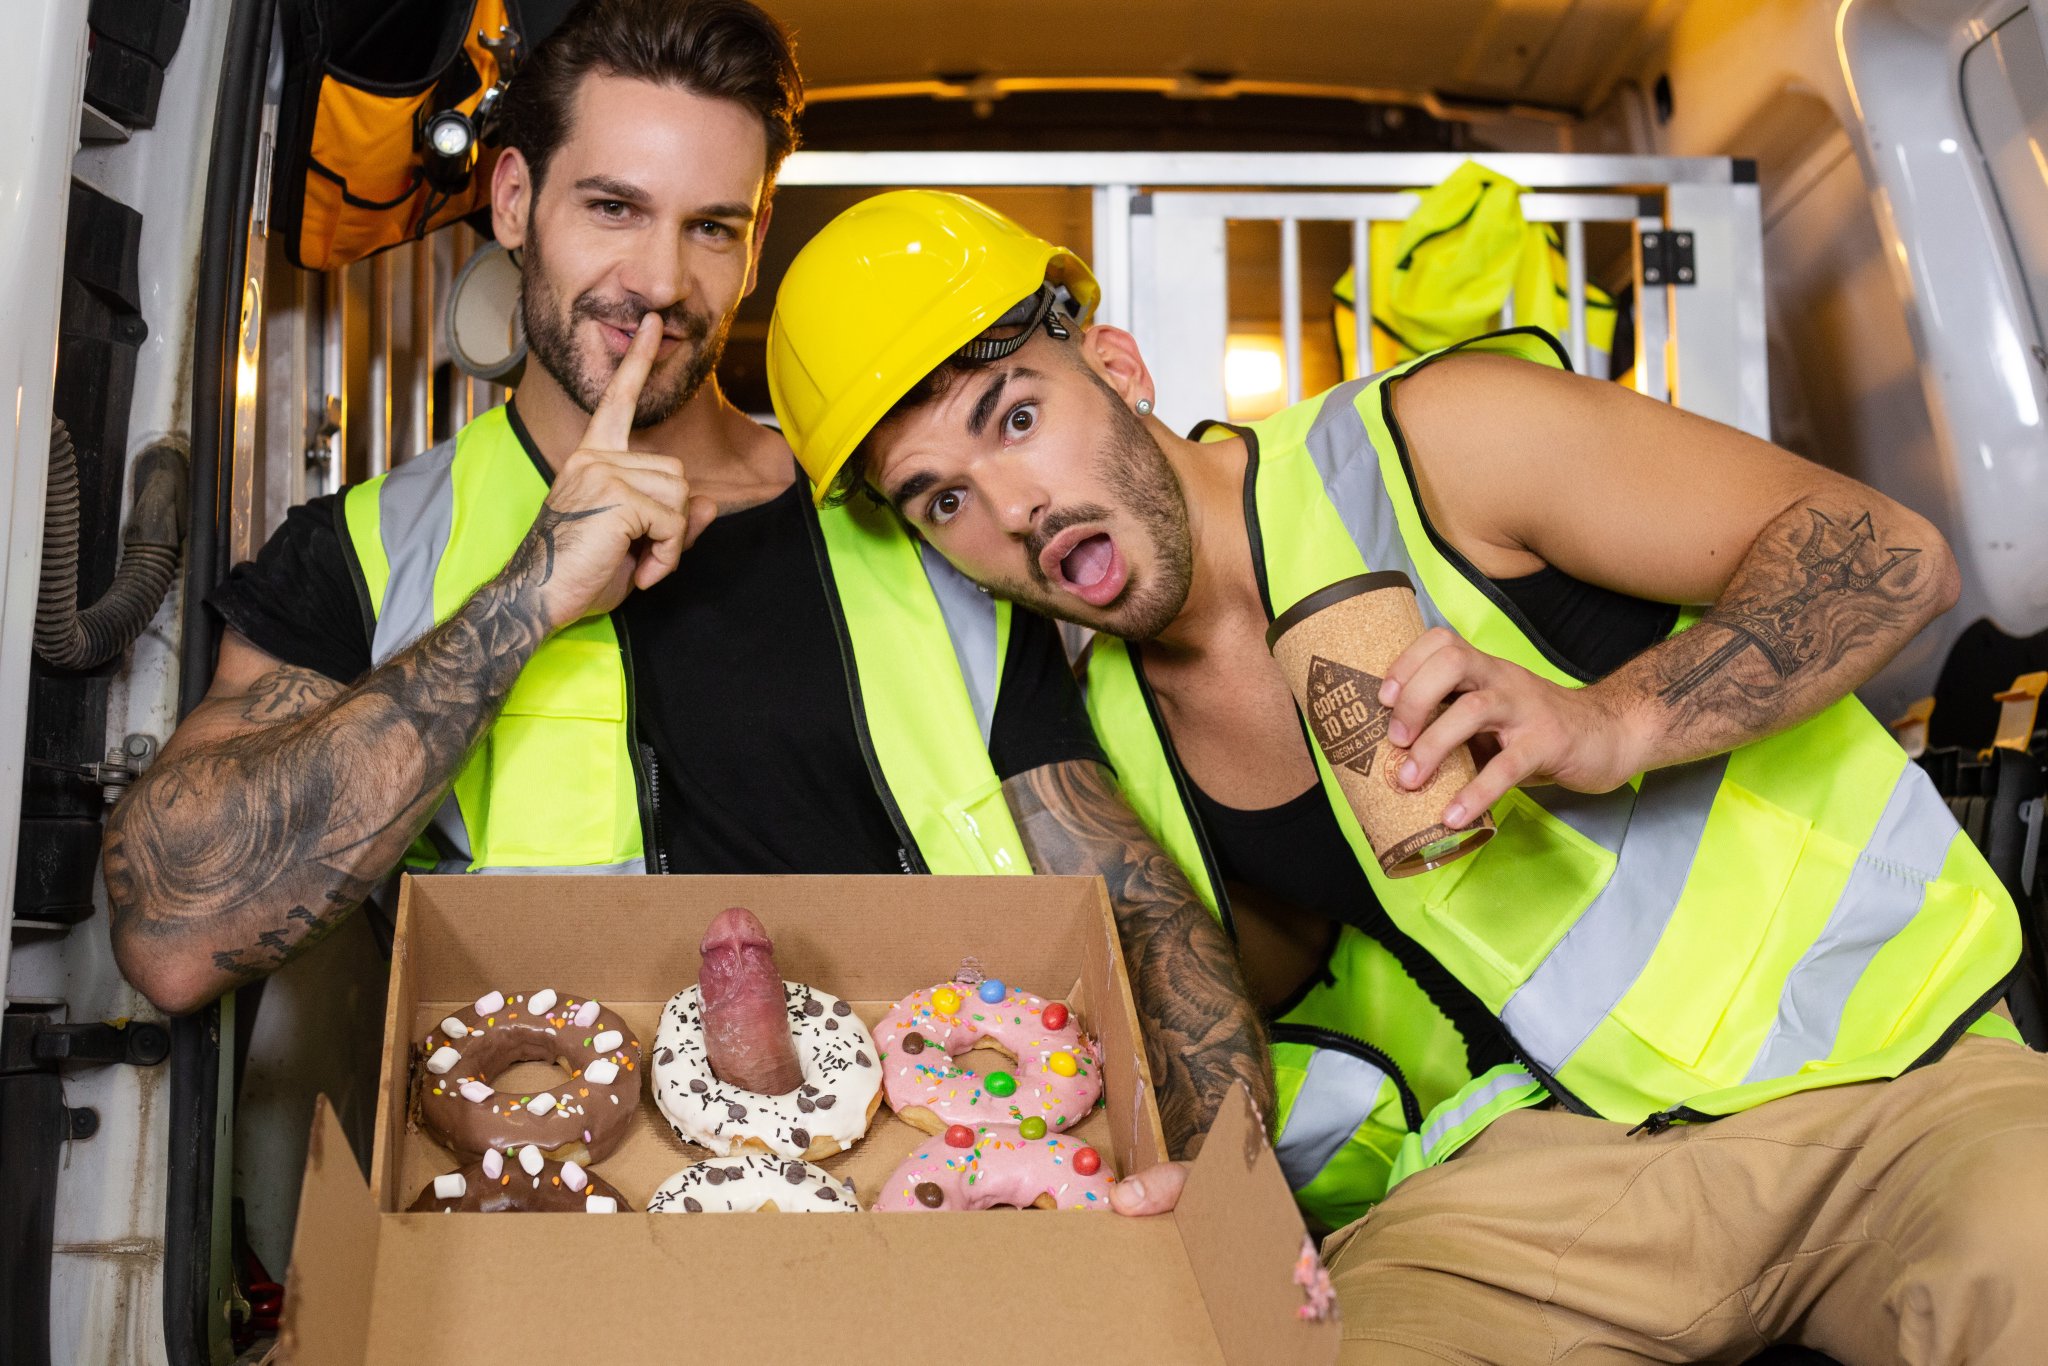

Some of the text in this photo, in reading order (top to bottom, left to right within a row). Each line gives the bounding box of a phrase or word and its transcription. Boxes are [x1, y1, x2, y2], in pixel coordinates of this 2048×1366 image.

[1313, 679, 1360, 720] COFFEE
[1322, 700, 1369, 741] TO GO
[1332, 722, 1386, 762] FRESH & HOT
